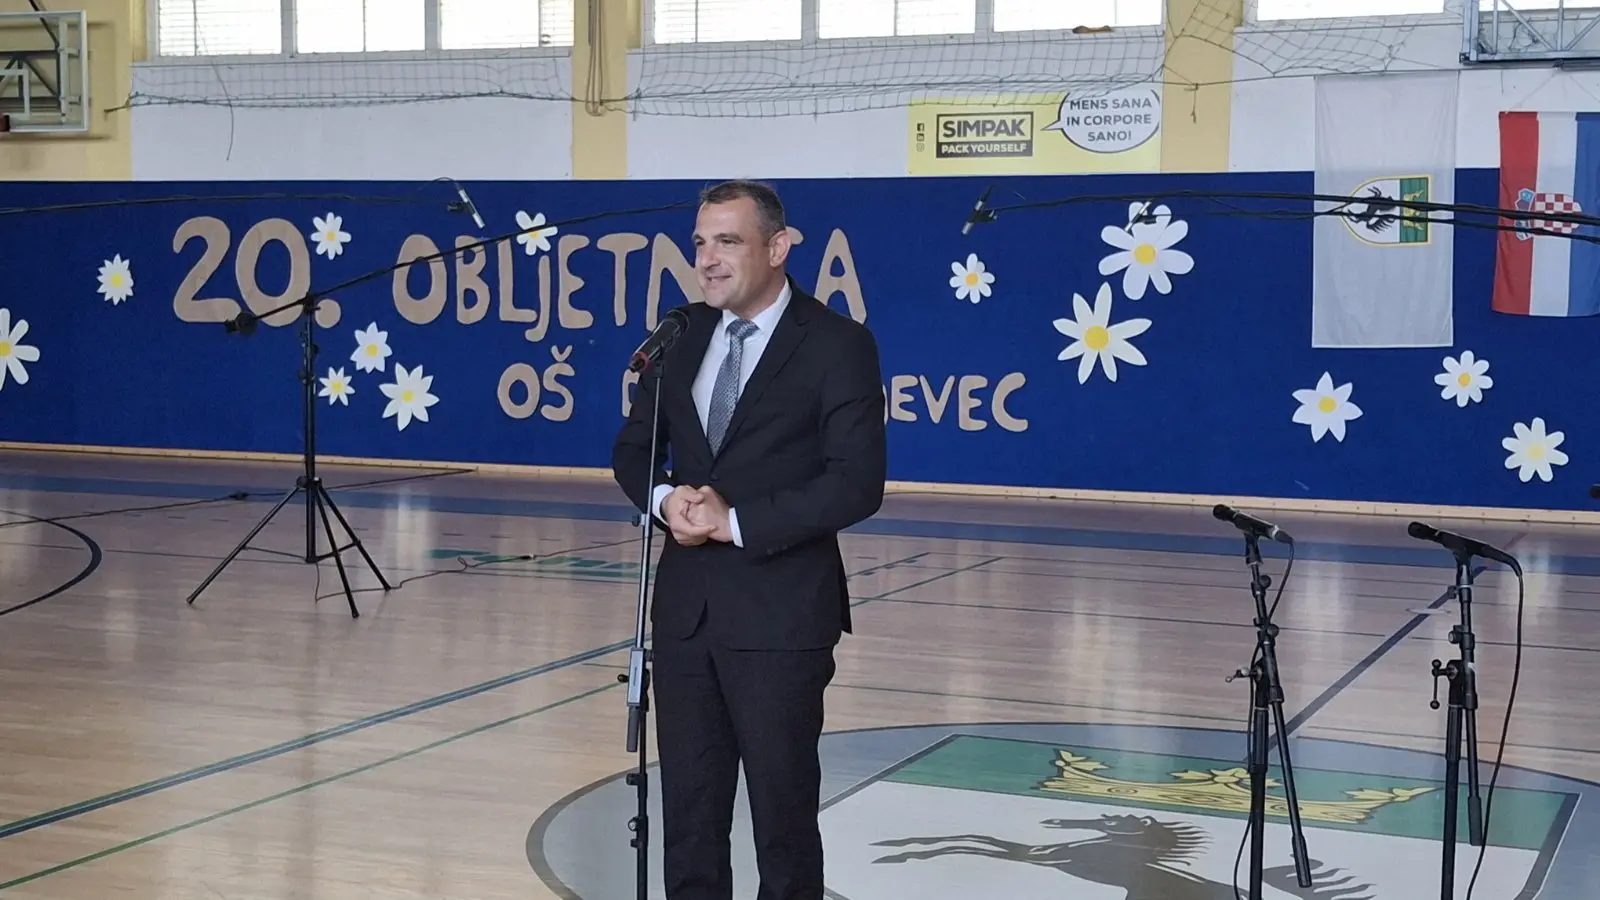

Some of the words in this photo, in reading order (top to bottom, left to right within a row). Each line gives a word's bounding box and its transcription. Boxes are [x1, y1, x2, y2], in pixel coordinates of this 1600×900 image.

[1069, 98, 1109, 111] MENS
[1113, 97, 1153, 109] SANA
[1066, 116, 1081, 127] IN
[1083, 113, 1153, 126] CORPORE
[941, 117, 1026, 139] SIMPAK
[1087, 131, 1132, 143] SANO!
[940, 144, 968, 155] PACK
[969, 142, 1027, 154] YOURSELF
[172, 215, 341, 328] 20.
[392, 226, 867, 343] OBLJETNA
[496, 345, 575, 422] OŠ
